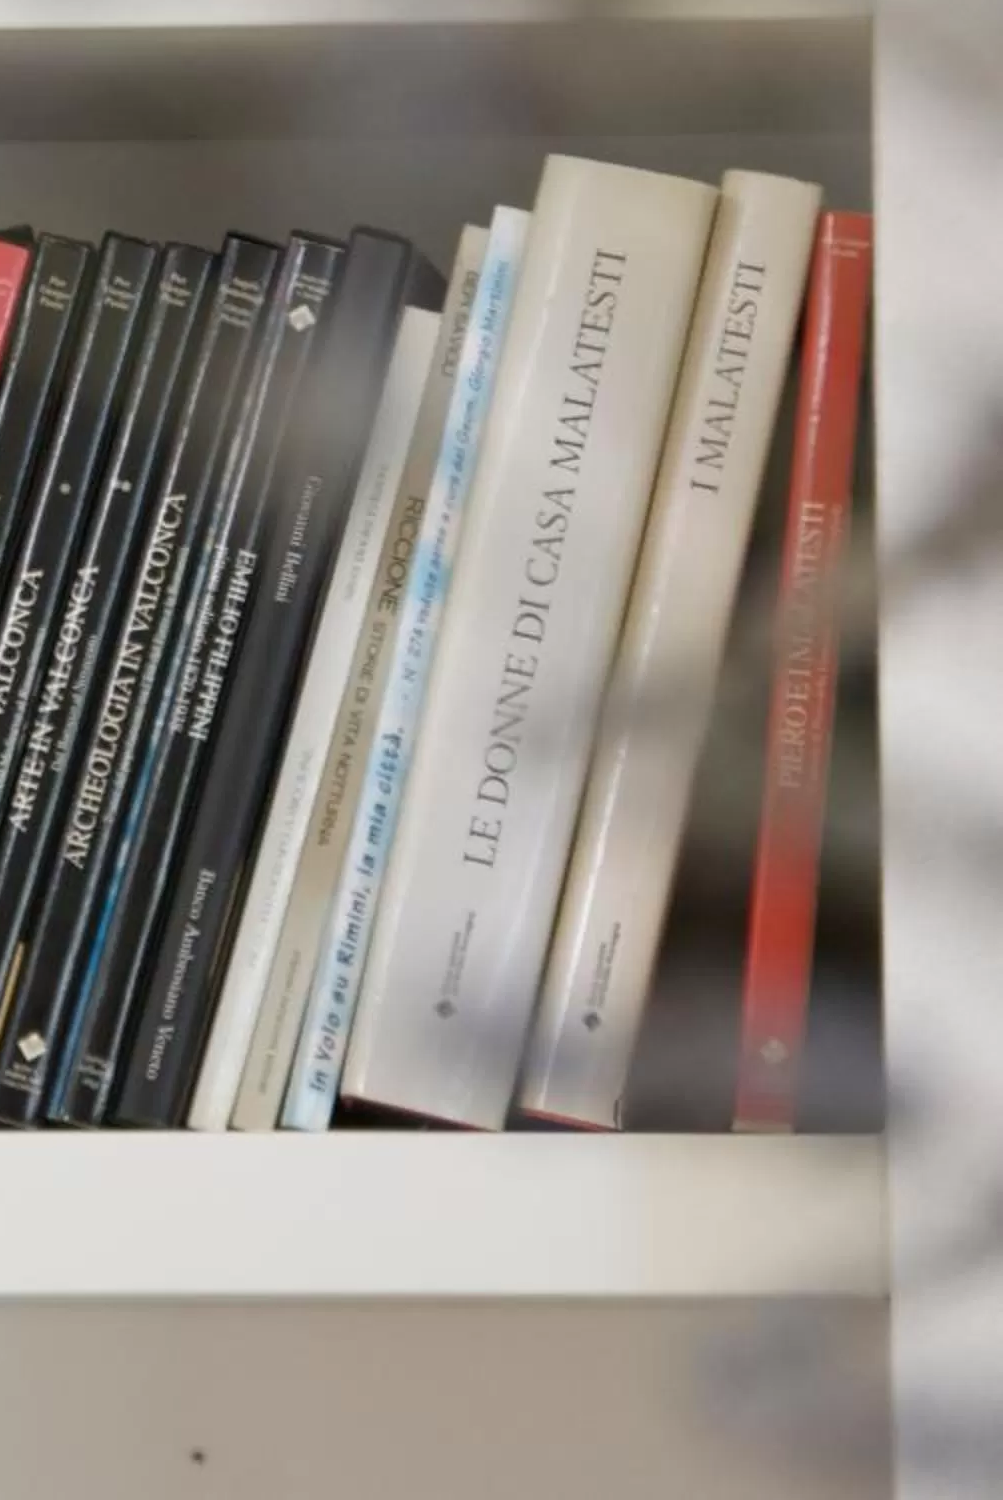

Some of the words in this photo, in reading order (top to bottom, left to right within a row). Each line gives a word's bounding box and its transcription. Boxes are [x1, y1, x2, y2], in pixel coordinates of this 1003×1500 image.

[550, 247, 628, 475] MALATESTI
[693, 260, 766, 473] MALATESTI
[690, 480, 720, 495] I
[130, 493, 187, 644] VALCONCA
[375, 494, 425, 615] RICCIONE
[525, 485, 576, 587] CASA
[218, 550, 257, 633] EMILIO
[272, 549, 303, 605] Bellini
[40, 564, 101, 720] VALCONCA
[358, 620, 386, 681] STORIE
[513, 597, 550, 645] DI
[117, 643, 144, 678] IN
[188, 633, 235, 742] FILIPPINI
[342, 707, 363, 747] VITA
[352, 686, 369, 705] DI
[29, 718, 55, 752] IN
[369, 724, 406, 796] città.
[477, 653, 538, 807] DONNE
[778, 705, 809, 789] PIERO
[9, 754, 48, 833] ARTE
[63, 677, 134, 869] ARCHEOLOGIA
[315, 751, 352, 849] NOTTURNA
[362, 801, 389, 846] mia
[464, 816, 502, 869] LE
[181, 866, 217, 921] Banco
[356, 852, 377, 876] la
[333, 882, 372, 966] Rimini,
[150, 921, 209, 1022] Ambrosiano
[330, 975, 350, 1005] su
[138, 1021, 177, 1082] Veneto
[313, 1011, 343, 1063] Volo
[308, 1069, 329, 1093] In
